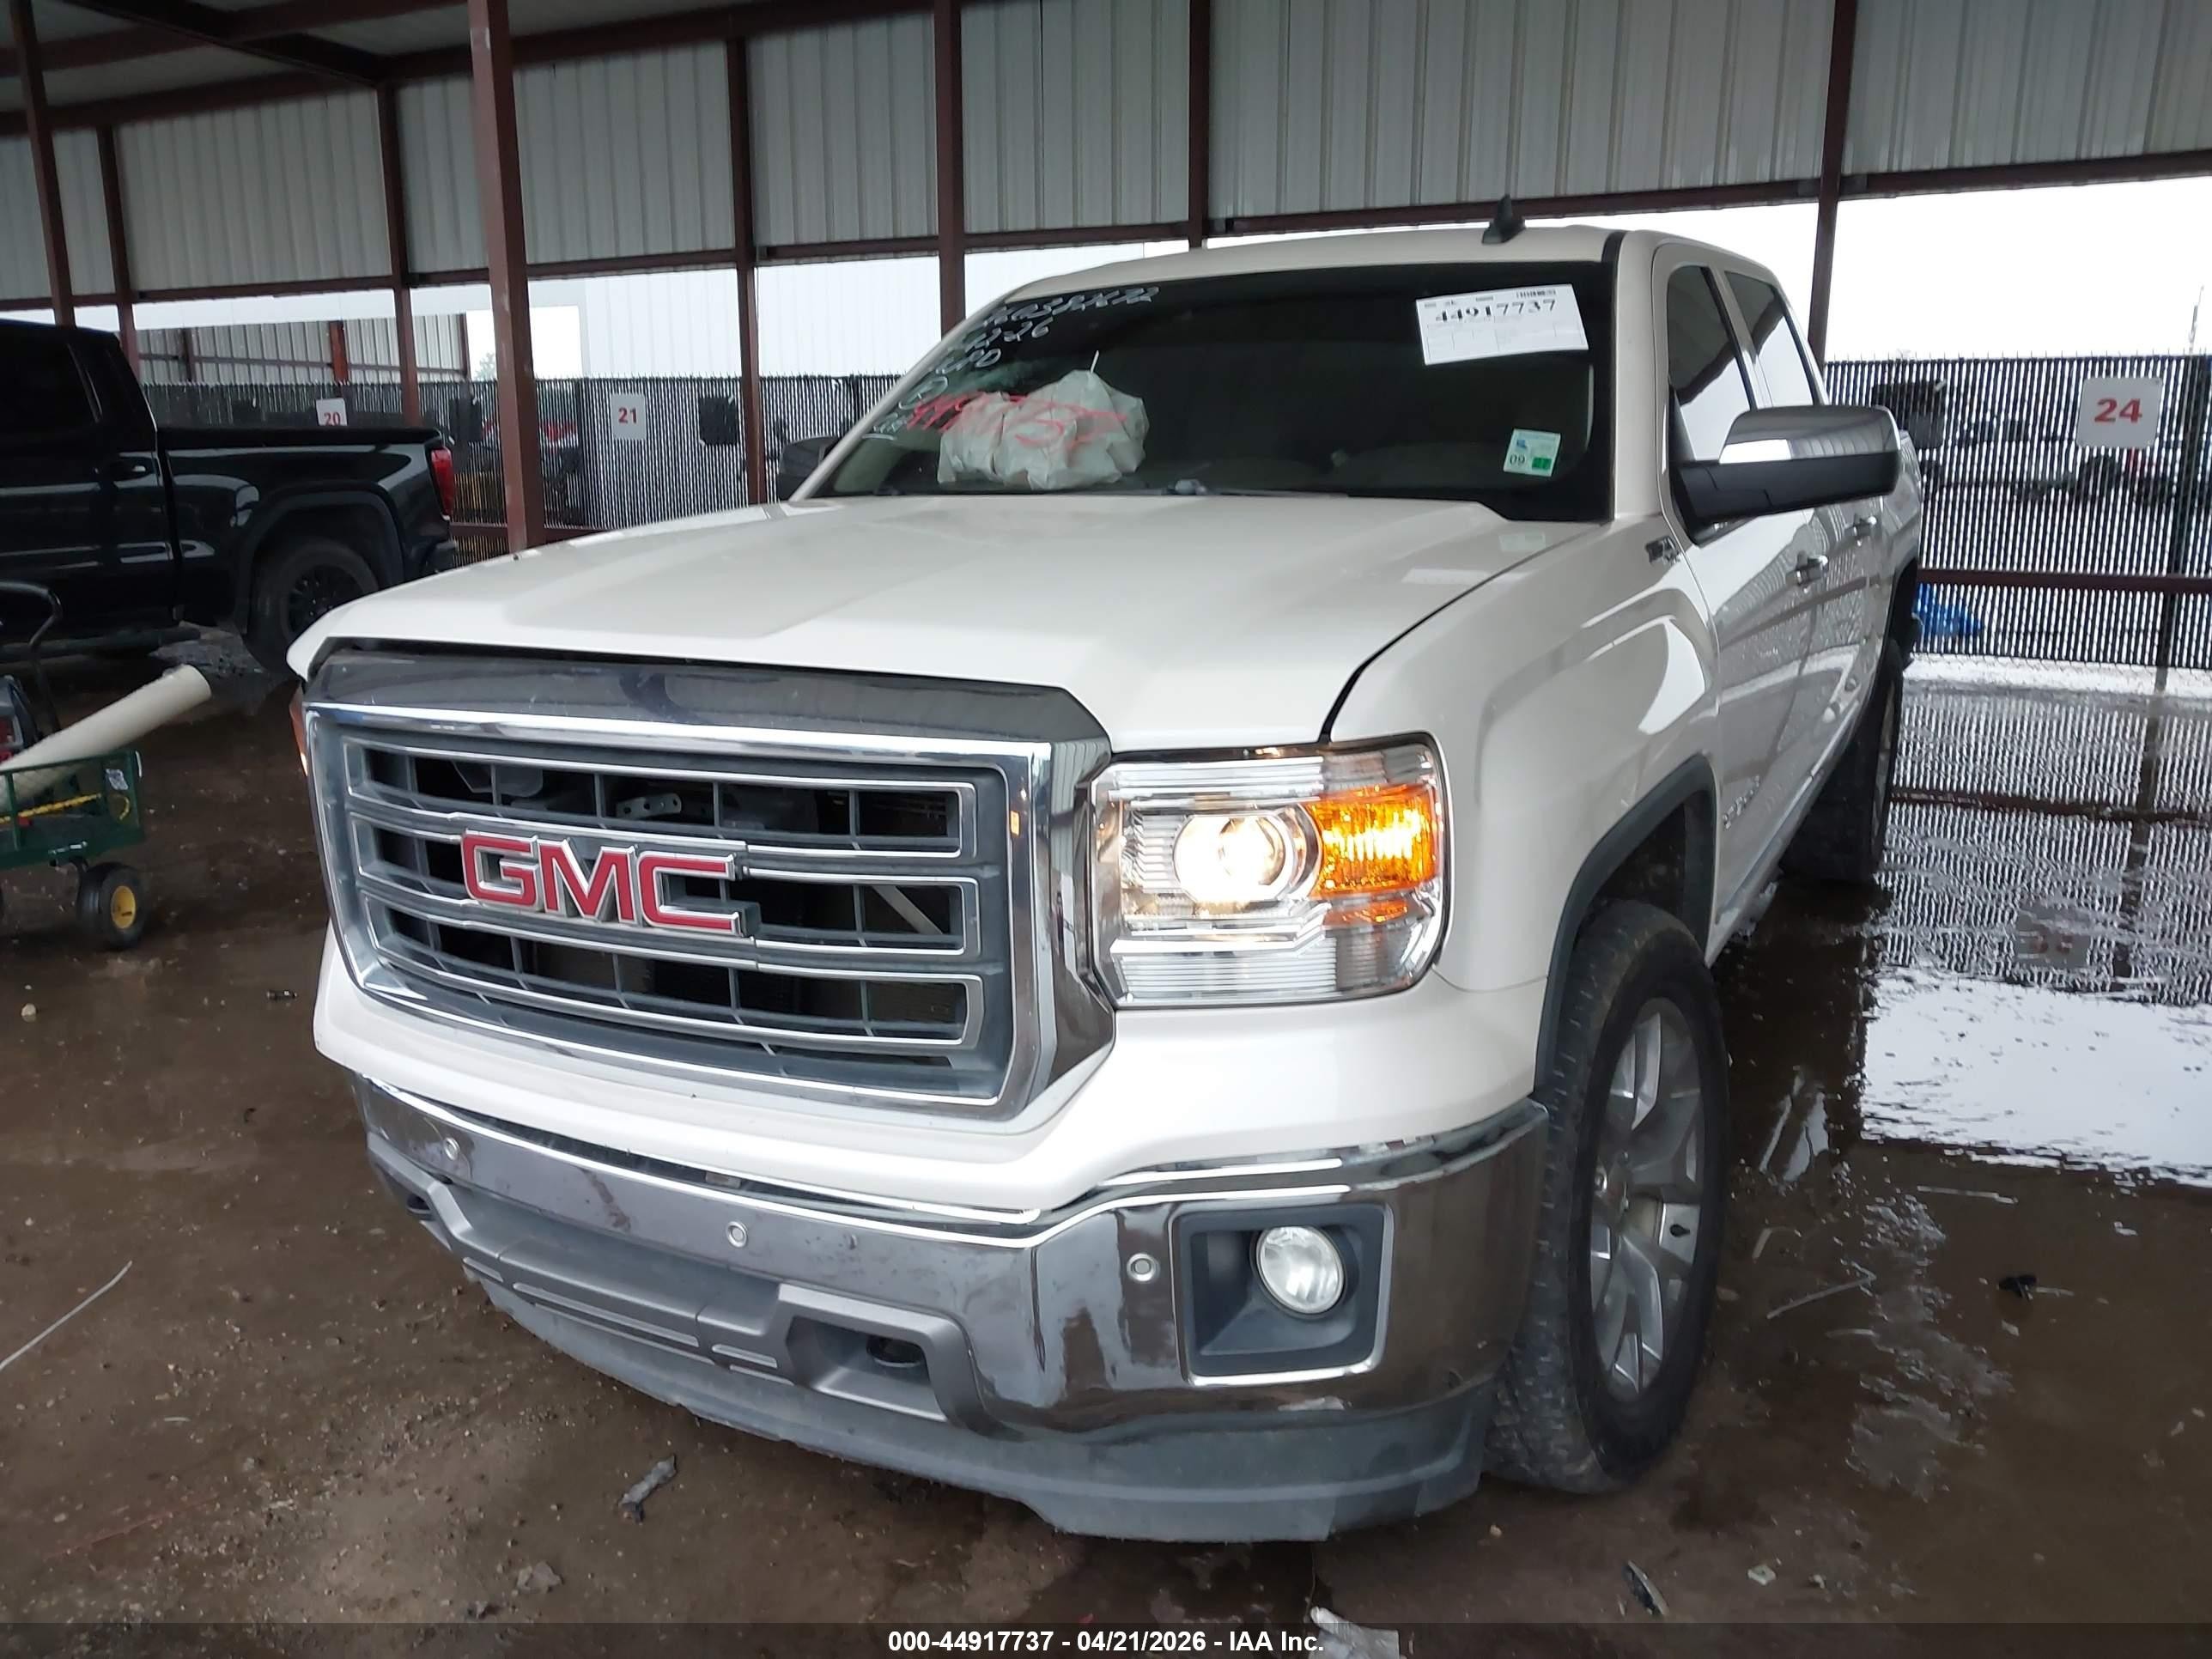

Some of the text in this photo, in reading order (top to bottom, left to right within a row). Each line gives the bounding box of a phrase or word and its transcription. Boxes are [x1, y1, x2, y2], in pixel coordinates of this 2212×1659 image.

[1435, 299, 1556, 322] 44917737
[324, 411, 341, 427] 20
[618, 406, 637, 424] 21
[2094, 398, 2142, 423] 24
[461, 829, 745, 937] GMC
